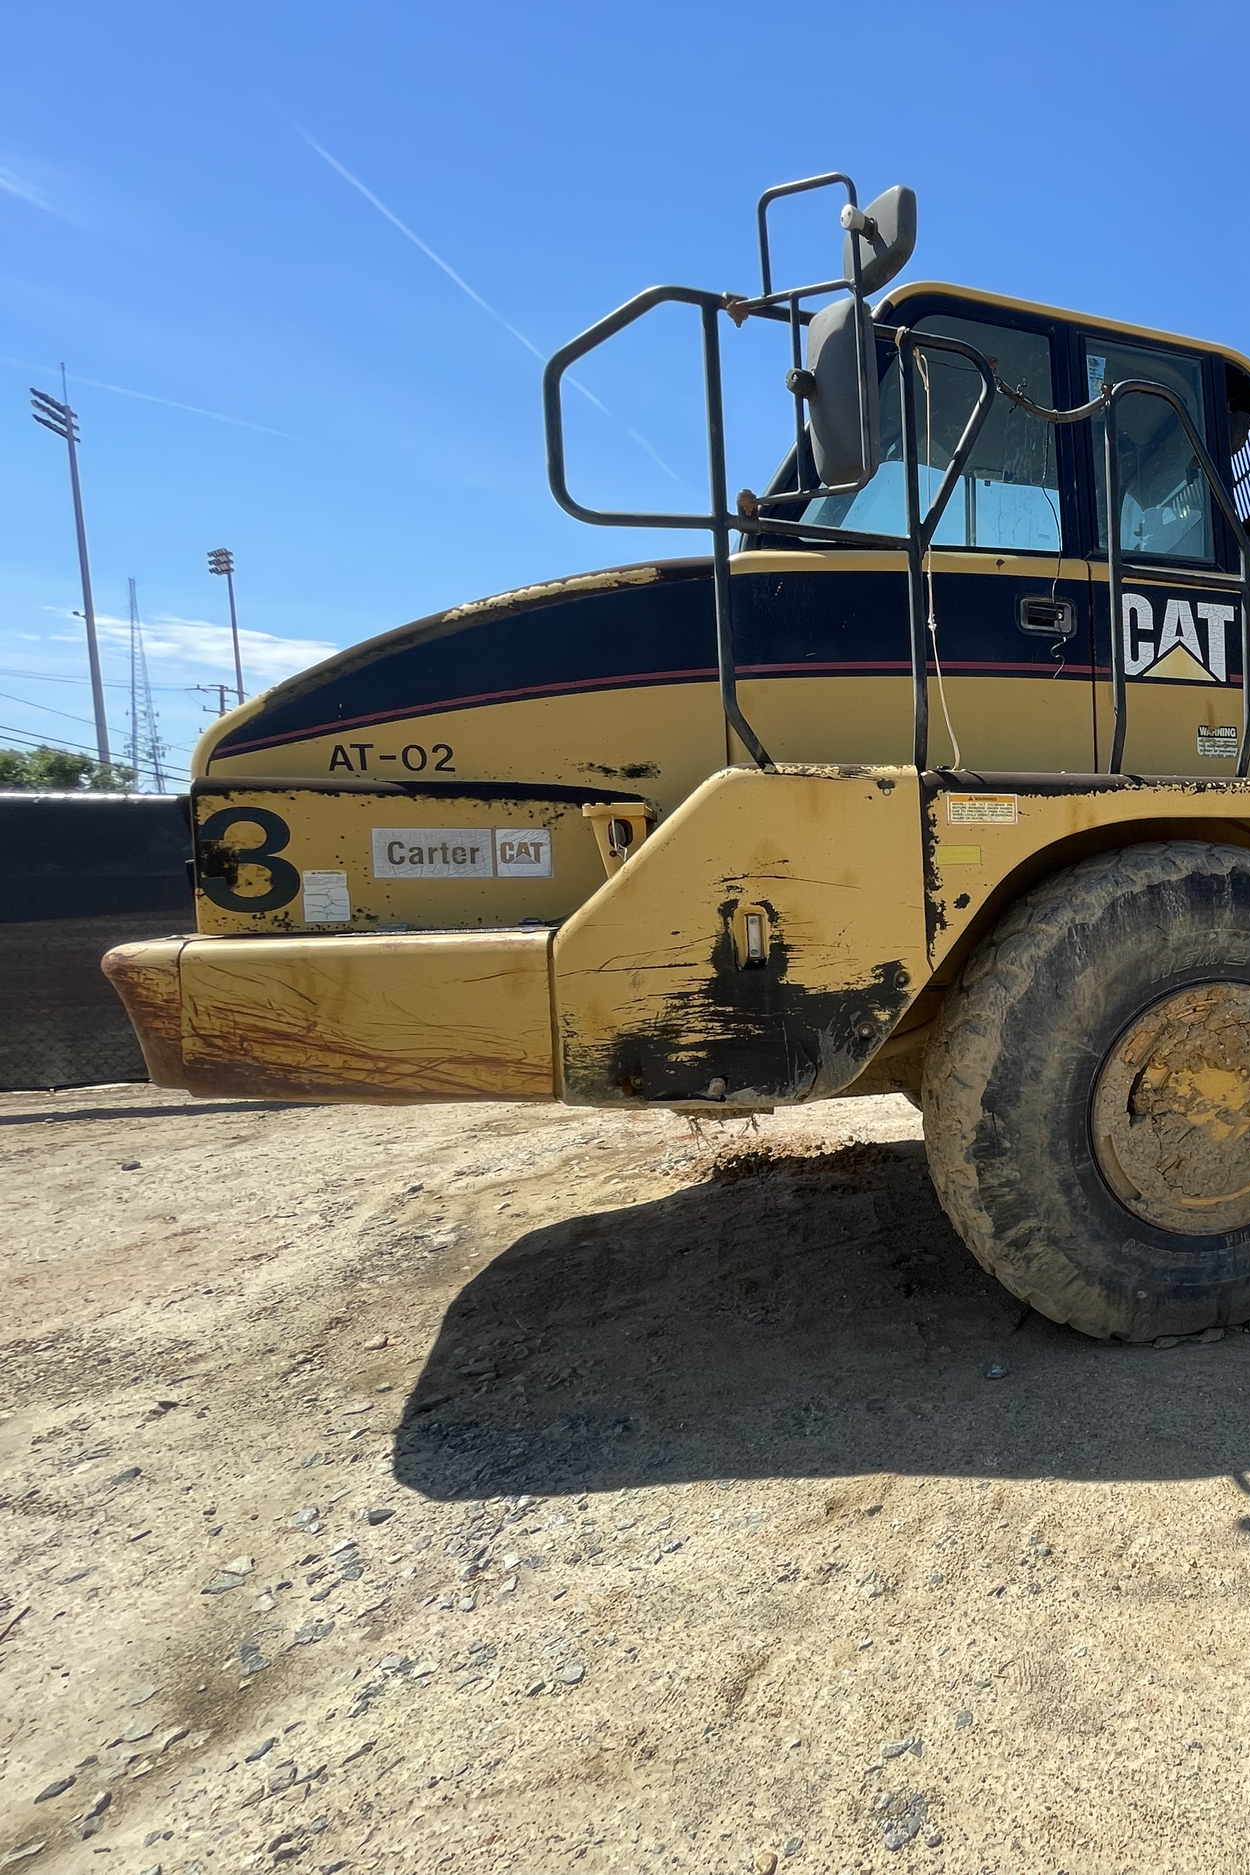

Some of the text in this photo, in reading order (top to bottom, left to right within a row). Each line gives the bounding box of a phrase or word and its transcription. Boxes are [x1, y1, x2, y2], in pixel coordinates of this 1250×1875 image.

[1121, 593, 1234, 682] CAT
[1199, 726, 1236, 737] WARNING
[329, 743, 456, 772] AT-02
[200, 806, 300, 912] 3
[387, 840, 544, 865] Carter CAT
